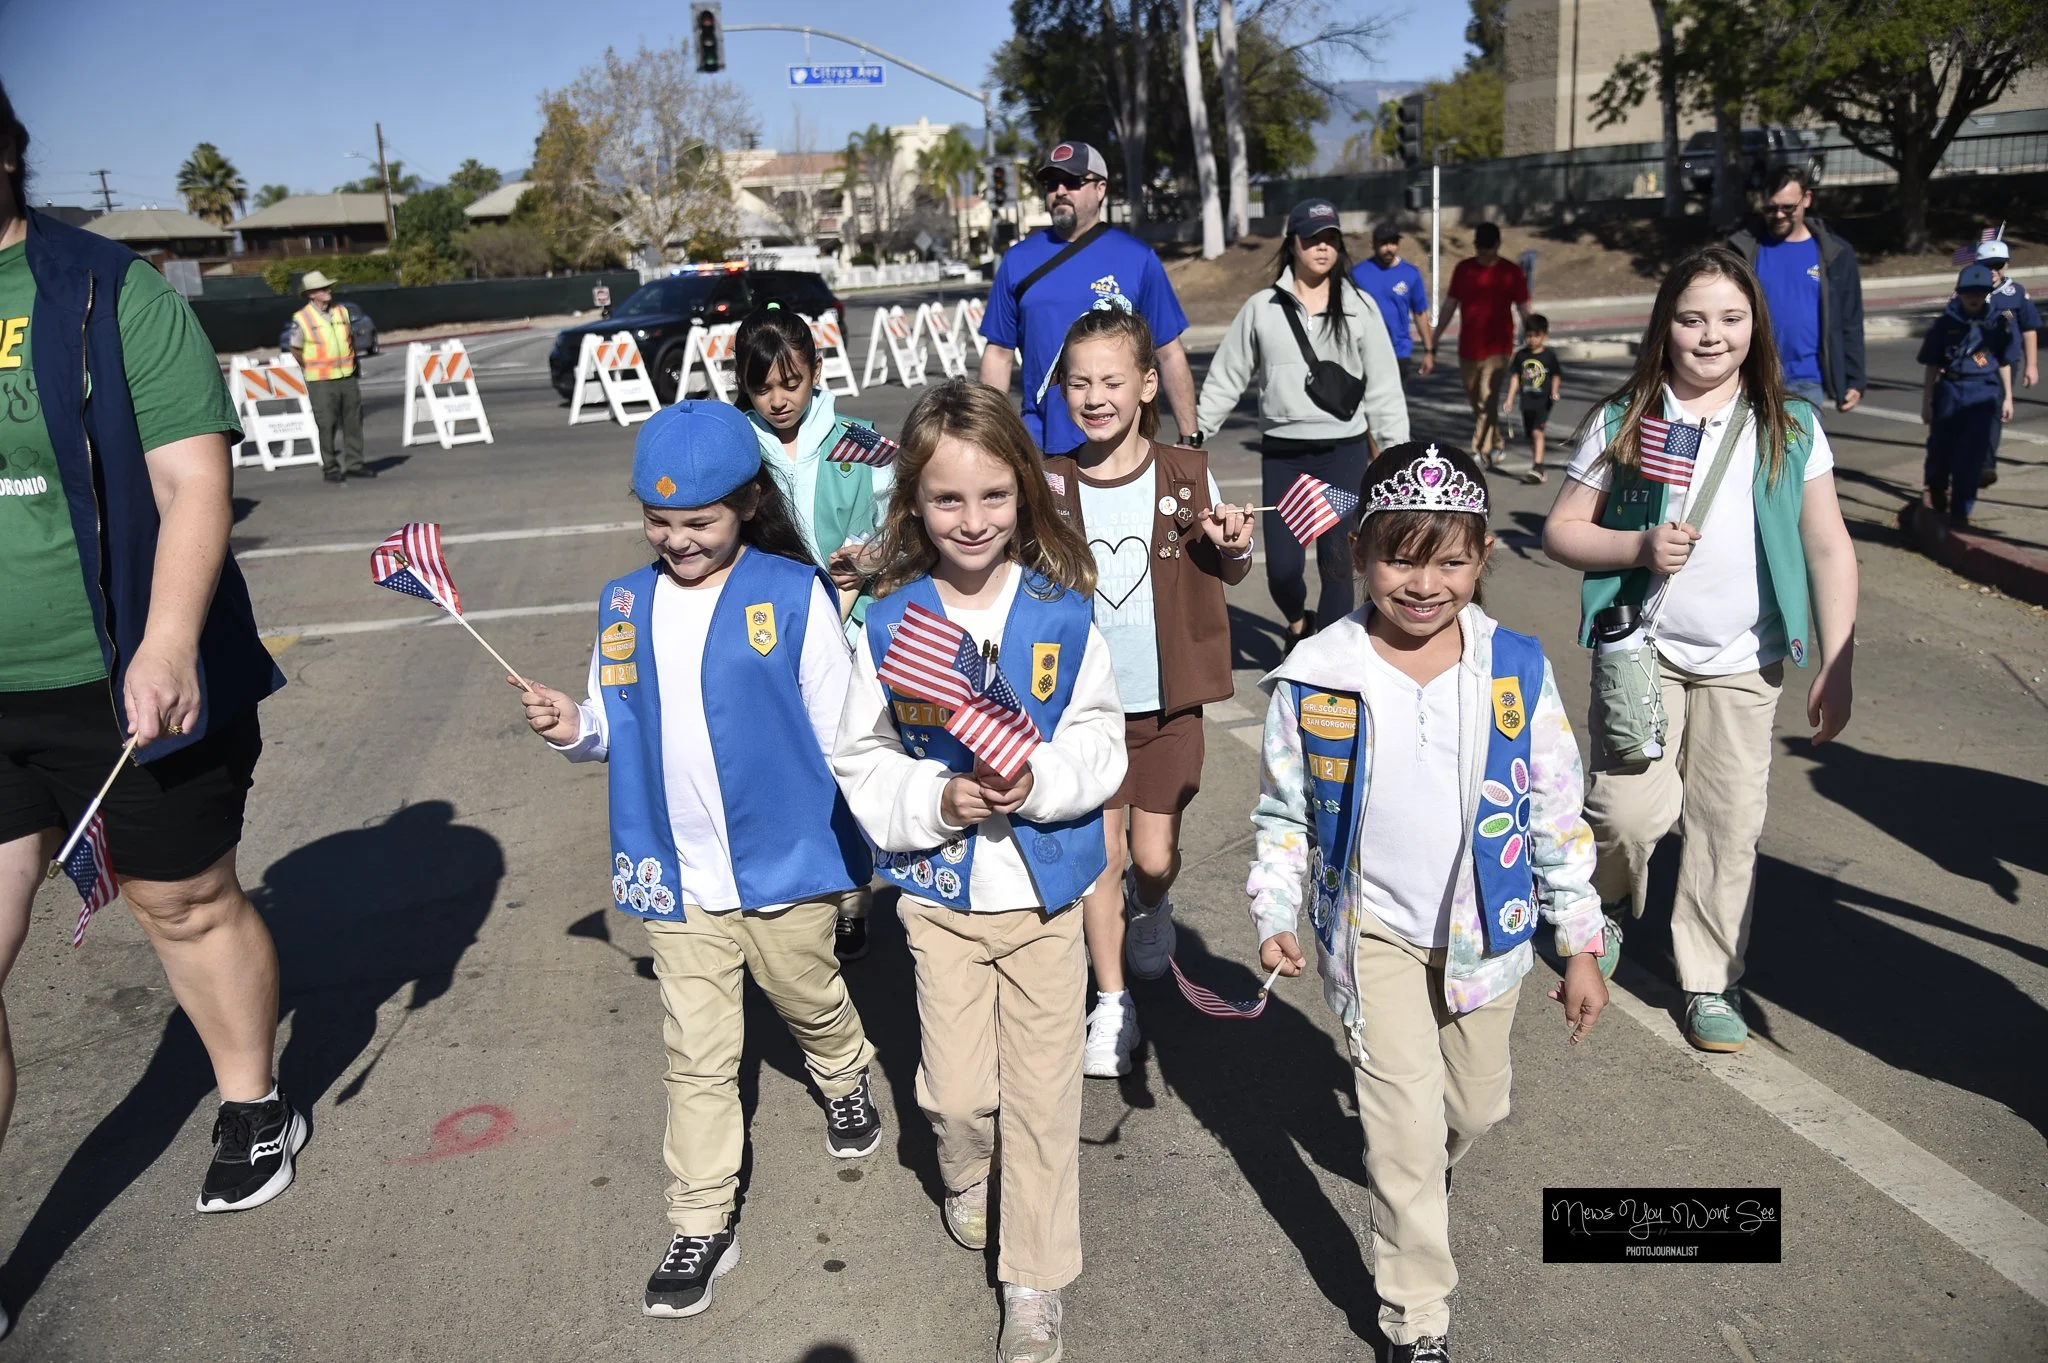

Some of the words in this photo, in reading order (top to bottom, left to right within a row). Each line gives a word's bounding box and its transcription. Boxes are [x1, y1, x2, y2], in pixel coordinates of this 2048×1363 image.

[812, 67, 853, 79] Citrus
[0, 316, 30, 370] E
[898, 704, 947, 723] 1270
[1303, 703, 1318, 711] GIRL
[1318, 704, 1348, 715] SCOUTS
[1348, 707, 1357, 716] US
[1306, 717, 1320, 726] SAN
